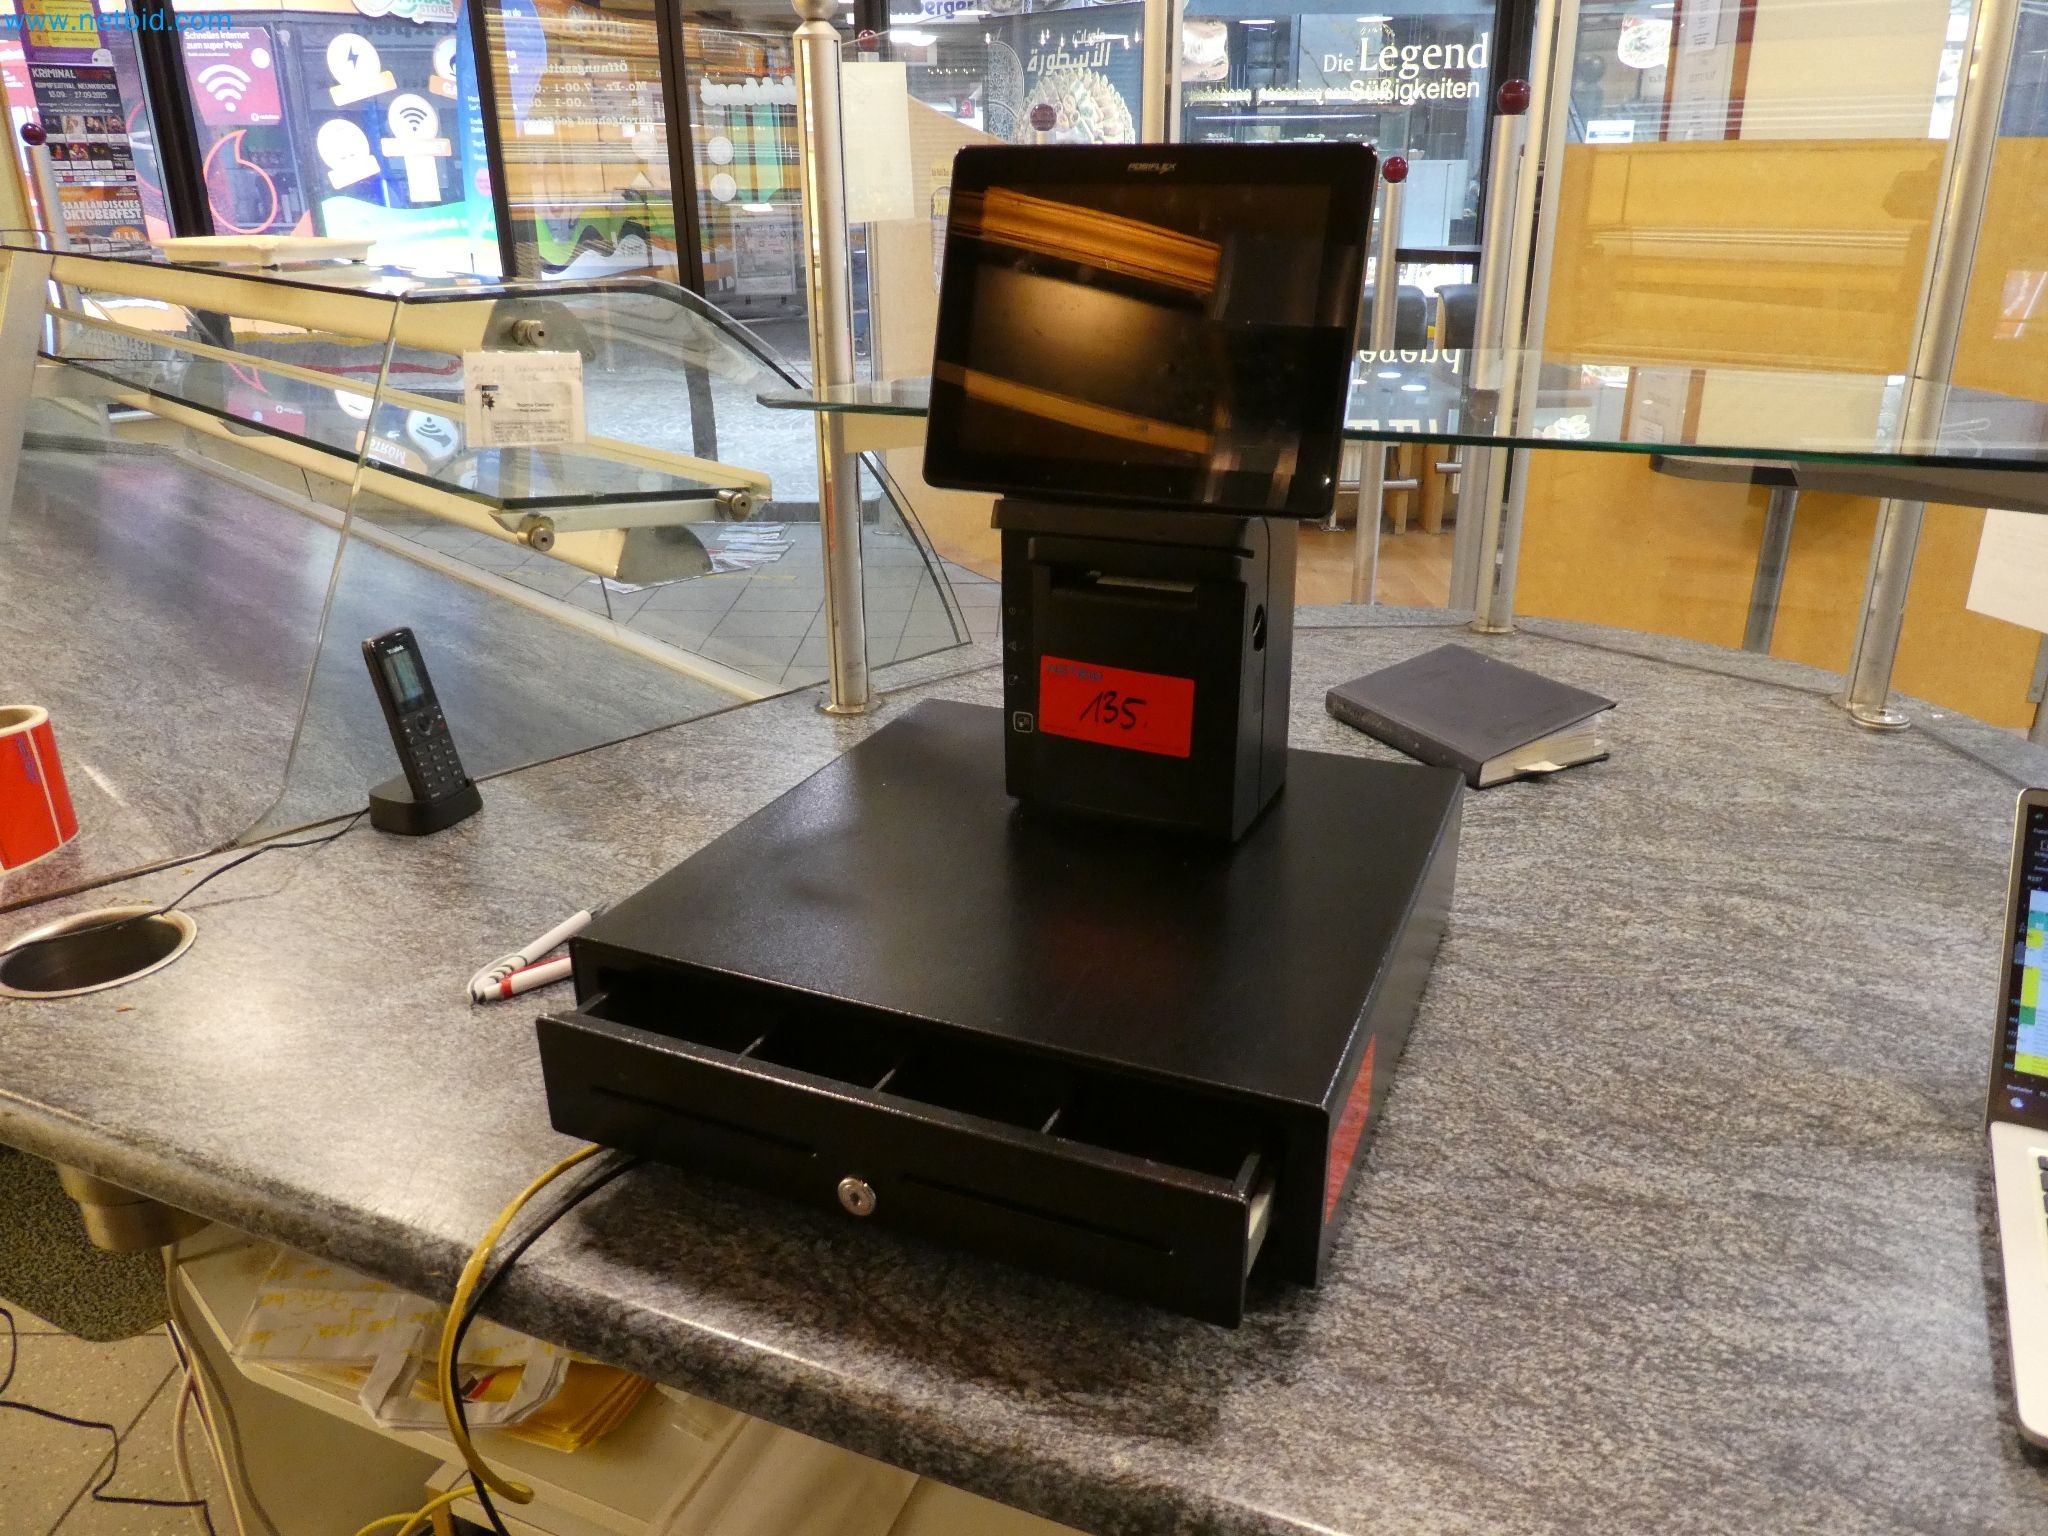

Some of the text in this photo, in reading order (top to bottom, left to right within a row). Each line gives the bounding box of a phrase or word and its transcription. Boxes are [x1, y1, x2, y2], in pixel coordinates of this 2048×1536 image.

[1323, 32, 1489, 80] Die Legend
[31, 68, 76, 79] KRIMINAL
[1350, 77, 1480, 106] Süßigkeiten
[63, 208, 142, 220] OKTOBERFEST
